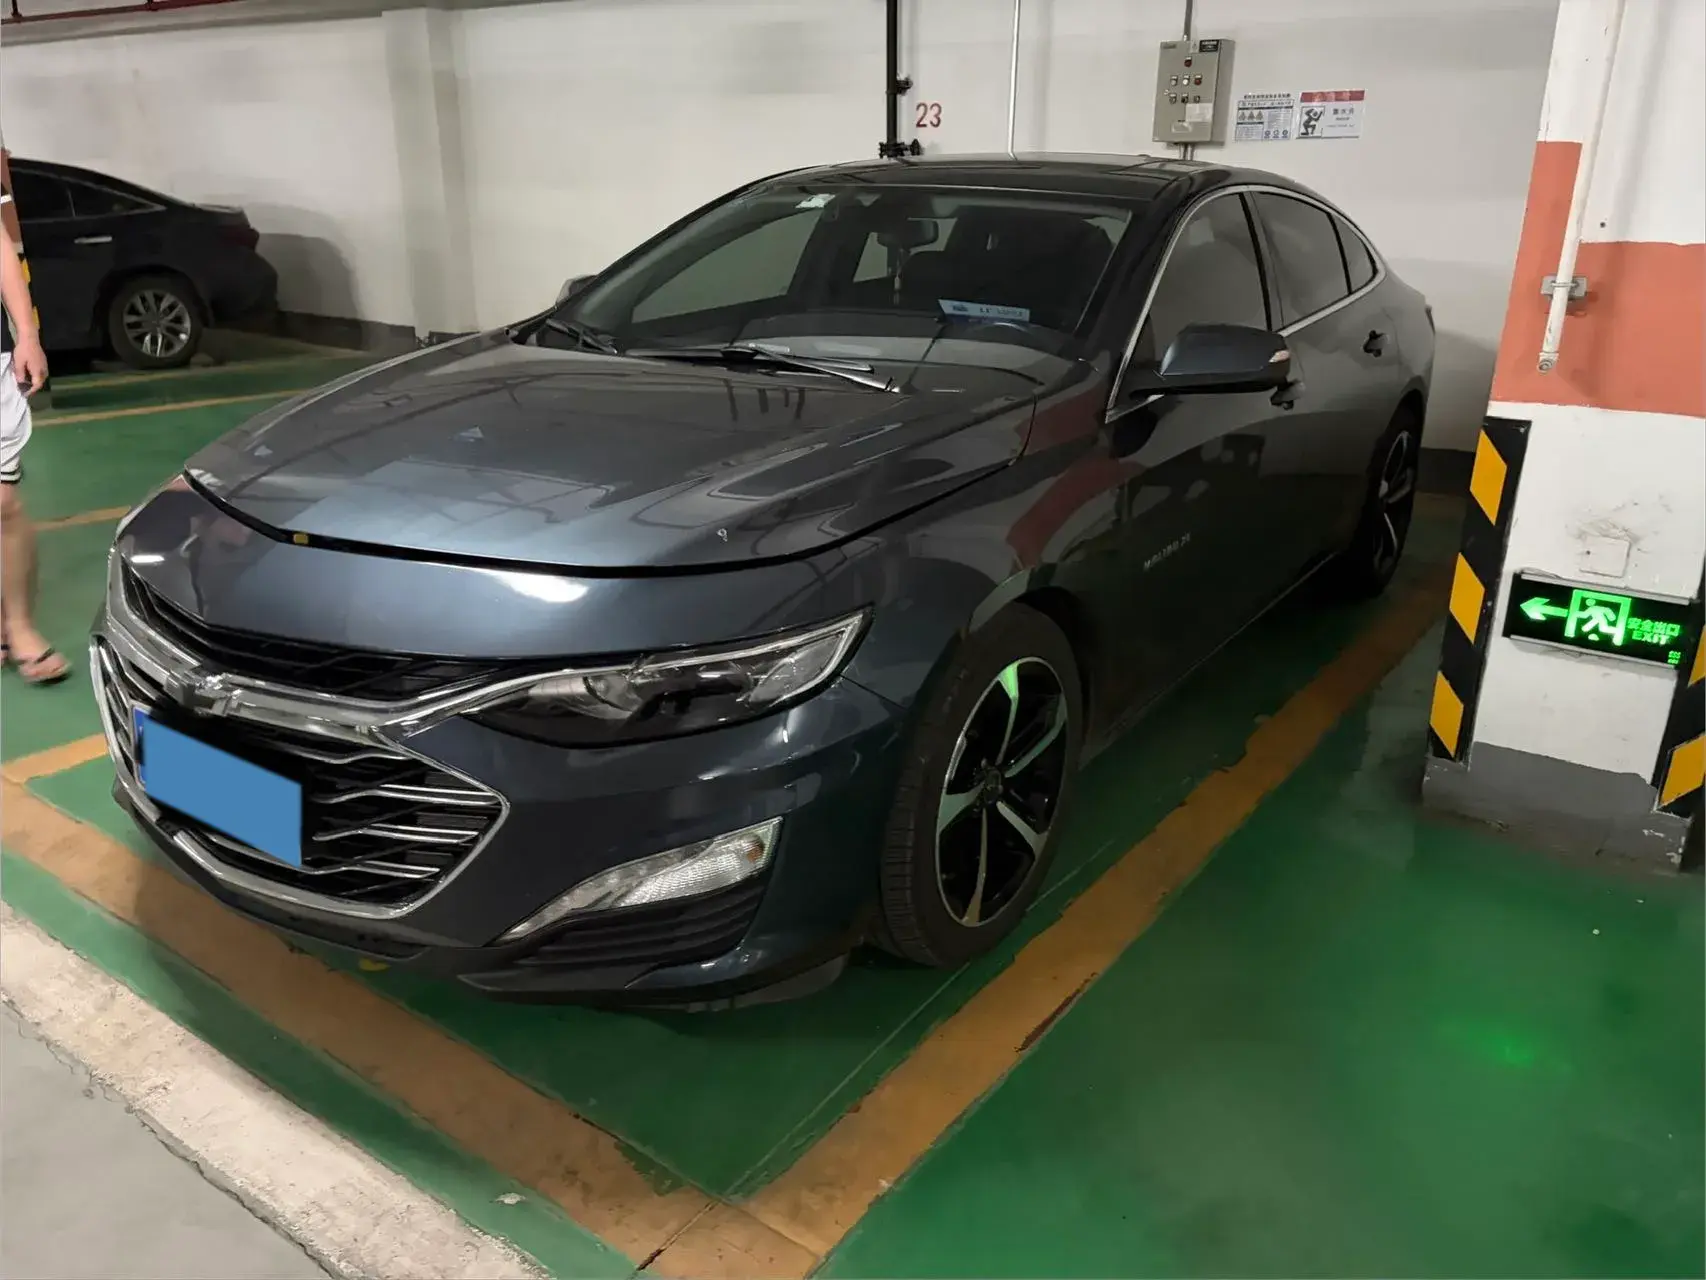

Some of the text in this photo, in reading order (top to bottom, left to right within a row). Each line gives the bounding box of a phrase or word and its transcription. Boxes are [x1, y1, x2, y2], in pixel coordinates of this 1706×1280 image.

[916, 102, 942, 128] 23
[1627, 617, 1681, 637] 安全出口
[1631, 630, 1670, 645] EXIT
